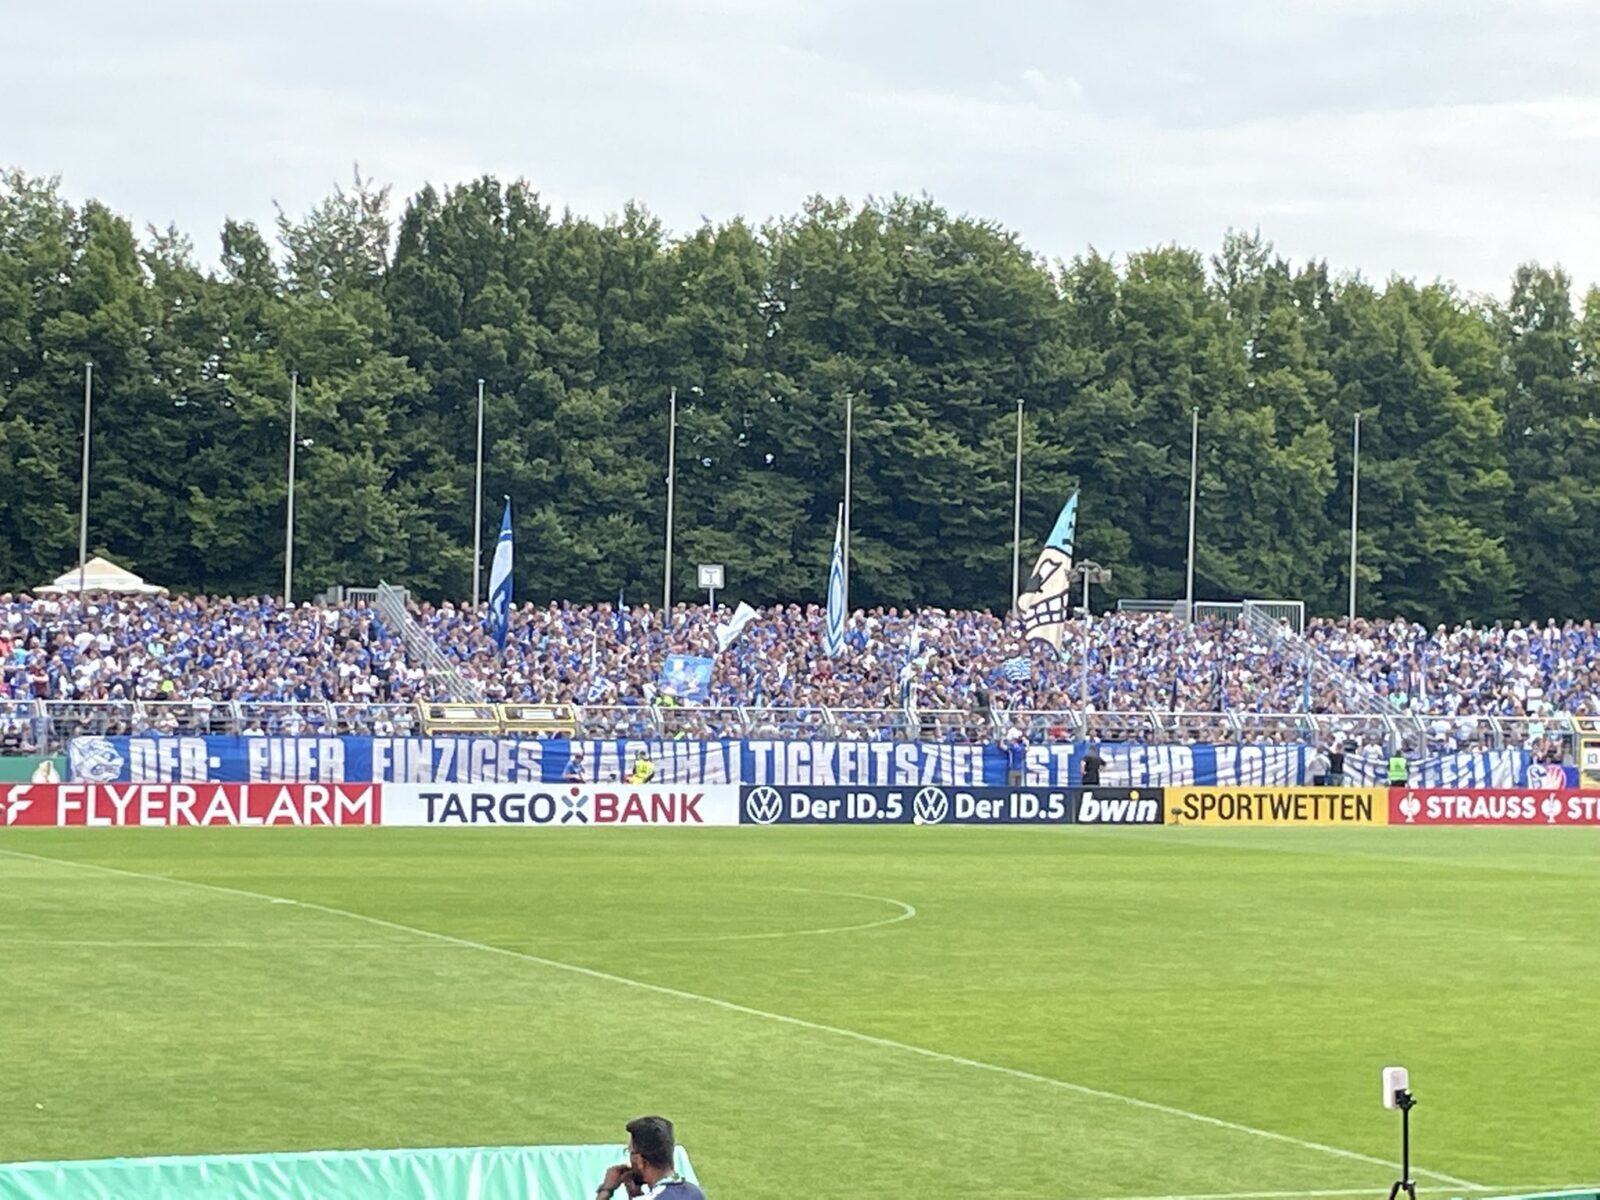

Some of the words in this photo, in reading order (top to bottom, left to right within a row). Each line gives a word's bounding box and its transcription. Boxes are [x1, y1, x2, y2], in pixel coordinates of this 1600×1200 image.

[249, 738, 345, 783] EUER
[373, 739, 543, 783] EINZIGES
[1021, 745, 1075, 786] ST
[57, 785, 373, 825] FLYERALARM
[790, 793, 841, 819] Der
[847, 794, 902, 819] ID.5
[955, 793, 1004, 819] Der
[1010, 794, 1065, 819] ID.5
[1079, 790, 1158, 822] bwin
[1184, 793, 1373, 821] SPORTWETTEN
[1426, 796, 1537, 820] STRAUSS
